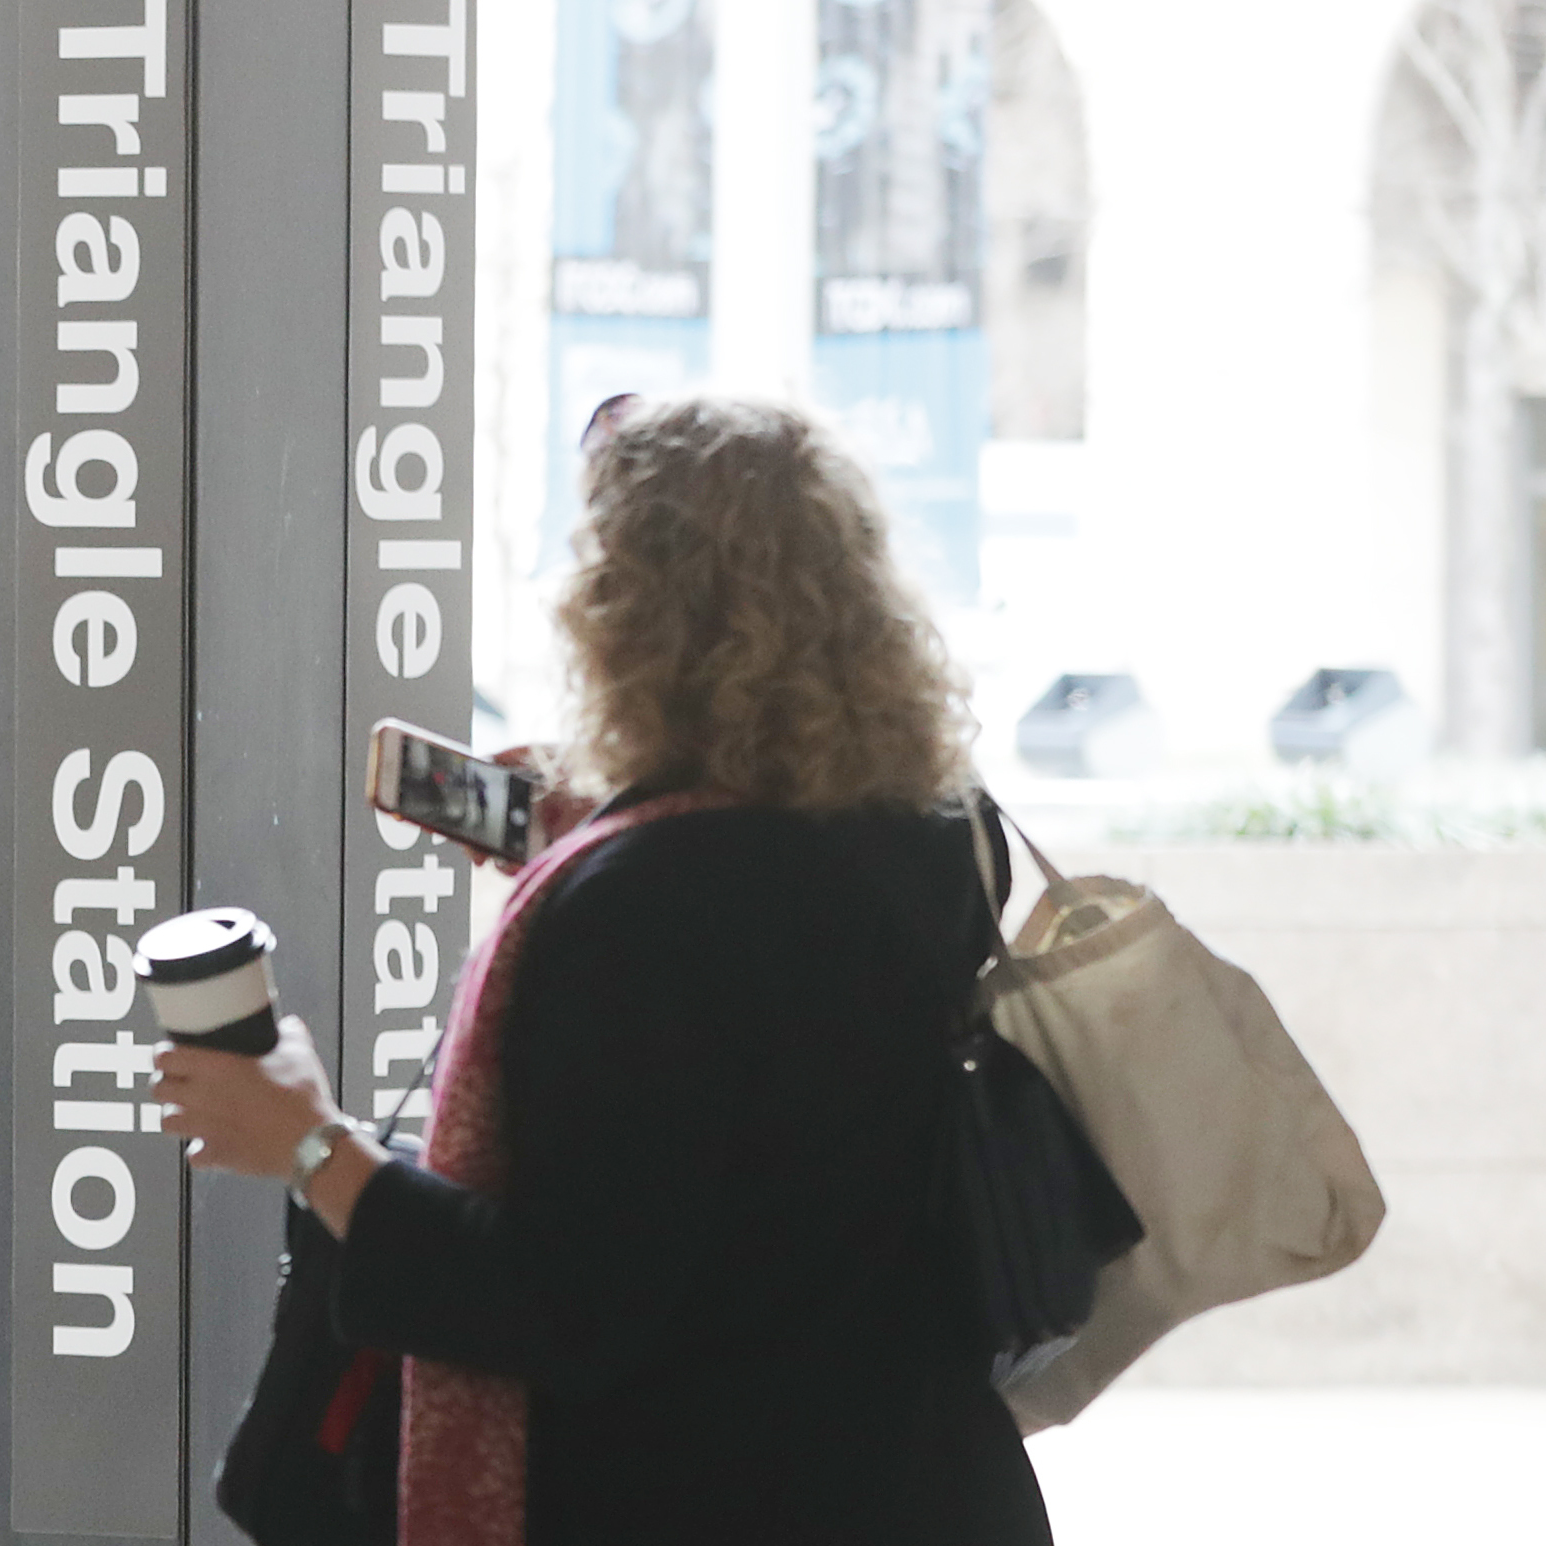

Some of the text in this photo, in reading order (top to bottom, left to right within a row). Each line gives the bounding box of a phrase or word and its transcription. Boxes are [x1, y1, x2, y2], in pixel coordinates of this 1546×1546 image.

[25, 0, 167, 1358] Triangle Station
[356, 0, 466, 1151] Triangle tati
